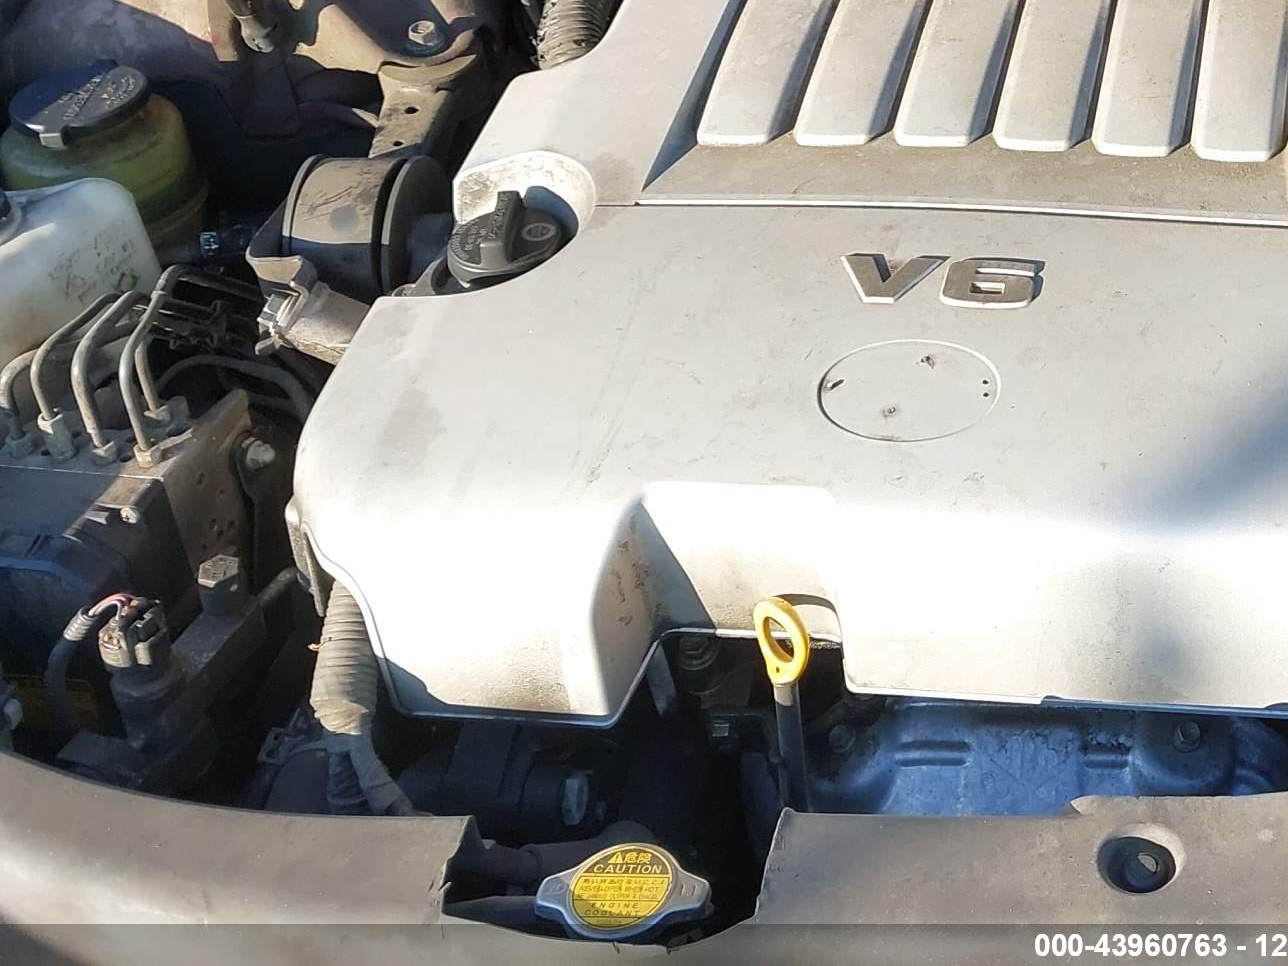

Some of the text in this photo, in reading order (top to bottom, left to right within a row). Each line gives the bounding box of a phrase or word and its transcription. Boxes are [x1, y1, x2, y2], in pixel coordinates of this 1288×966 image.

[840, 252, 1046, 310] V6
[593, 864, 663, 875] CAUTION
[591, 902, 640, 910] ENGINE
[584, 909, 642, 917] COOLANT
